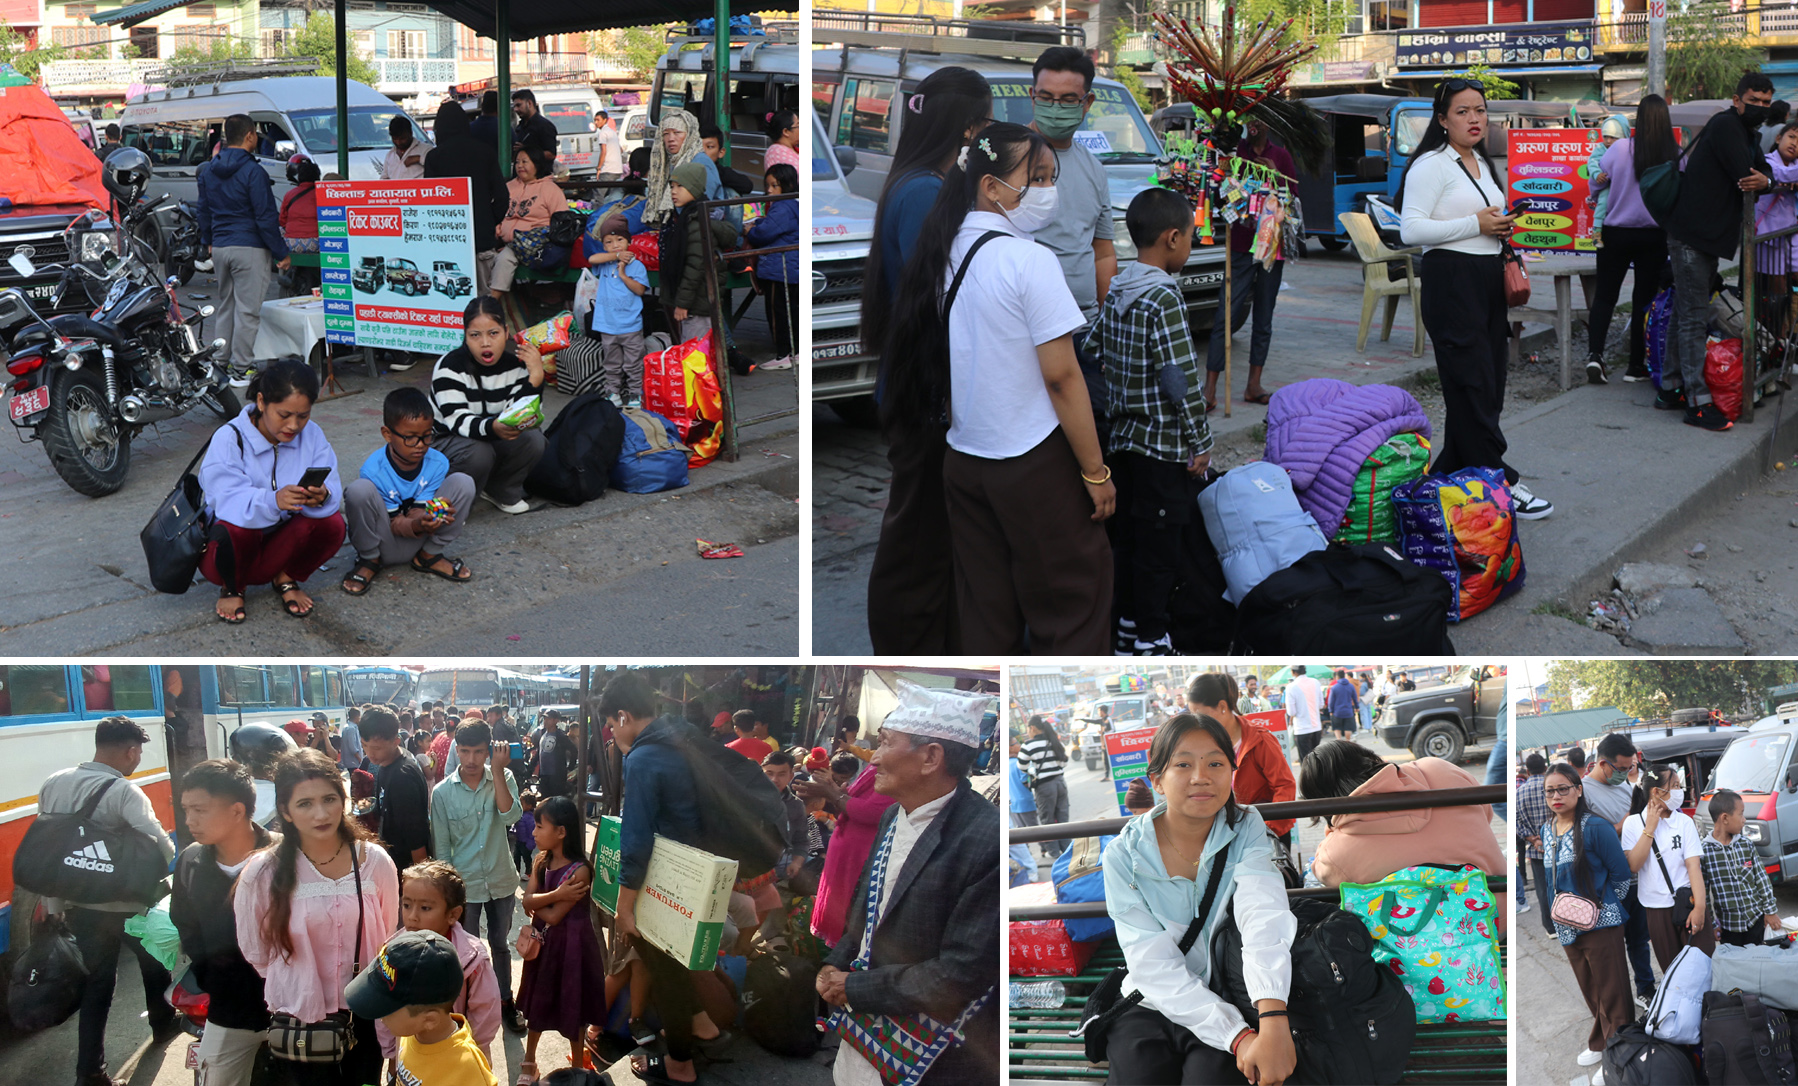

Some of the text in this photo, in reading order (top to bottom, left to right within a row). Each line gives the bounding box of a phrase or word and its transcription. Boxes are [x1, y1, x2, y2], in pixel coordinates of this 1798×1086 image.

[1412, 30, 1449, 46] हाम्रो
[1516, 36, 1526, 46] &
[990, 84, 1122, 102] HER ELS
[134, 107, 158, 116] TOYOTA
[1516, 142, 1549, 154] अरुण
[1552, 142, 1582, 154] बरुण
[1518, 164, 1565, 176] तुम्लिङटार
[370, 188, 417, 198] यातायात
[420, 185, 455, 198] प्रा.लि.
[1522, 181, 1562, 190] खाँदबारी
[1524, 198, 1560, 211] ोजपुर
[402, 208, 418, 217] राजेश
[349, 210, 400, 230] टिकट काउन्टर
[403, 219, 420, 230] किरण
[404, 232, 423, 244] हेमराज
[324, 240, 343, 250] भोजपुर
[410, 311, 428, 322] टिकट
[1114, 752, 1142, 762] खाँदबारी
[600, 844, 621, 863] green
[64, 856, 114, 873] adidas
[645, 885, 694, 920] FORTUNER
[741, 990, 754, 1004] KE
